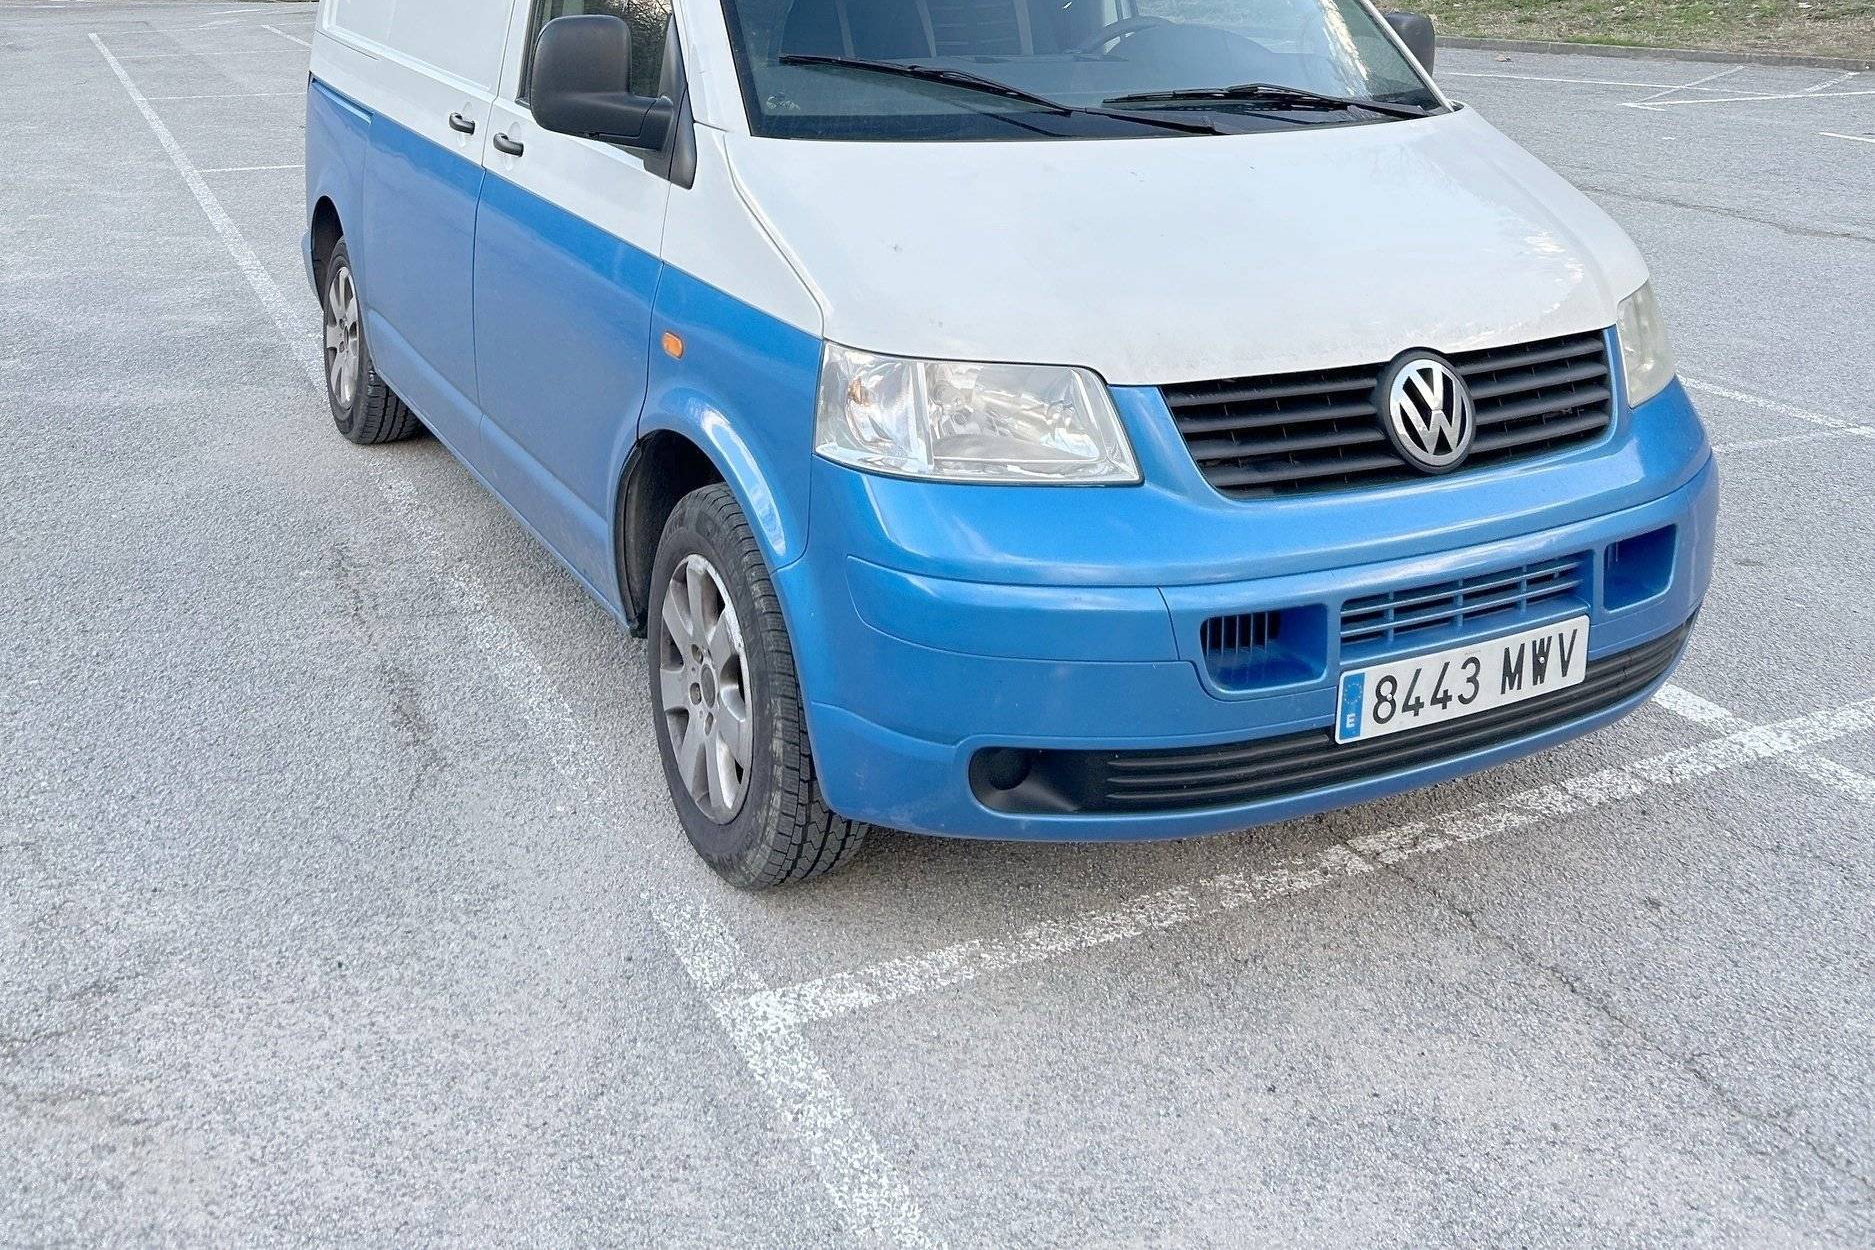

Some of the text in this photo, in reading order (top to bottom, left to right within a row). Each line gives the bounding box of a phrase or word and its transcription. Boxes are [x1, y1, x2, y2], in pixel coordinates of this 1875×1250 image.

[1392, 361, 1471, 464] VW
[1345, 712, 1356, 729] E
[1372, 628, 1578, 725] 8443 MWV
